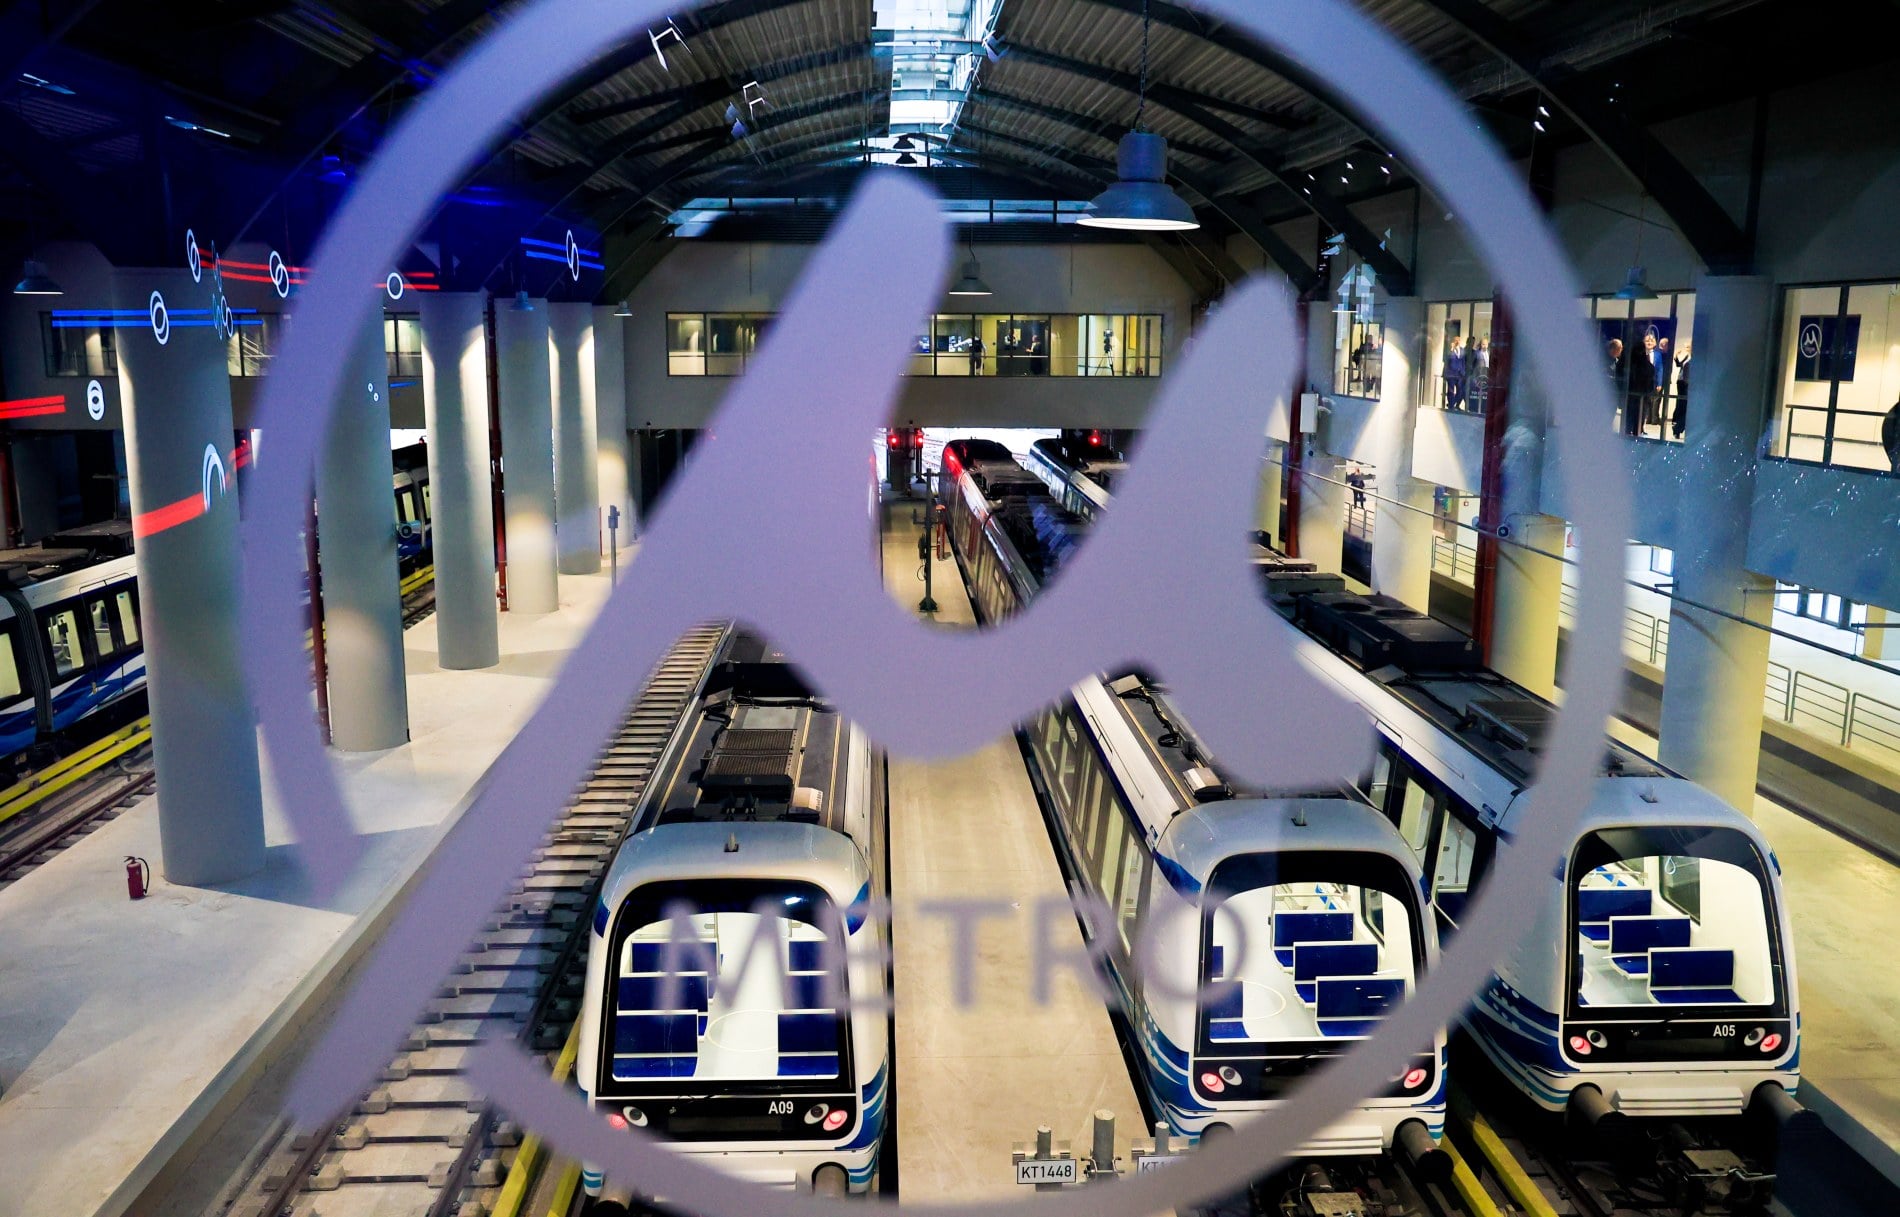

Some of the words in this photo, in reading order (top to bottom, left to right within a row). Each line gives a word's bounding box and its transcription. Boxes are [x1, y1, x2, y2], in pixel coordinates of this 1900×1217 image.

[660, 896, 1247, 1010] METRO
[1713, 1024, 1736, 1037] A05
[768, 1101, 794, 1114] A09
[1021, 1165, 1072, 1179] KT1448
